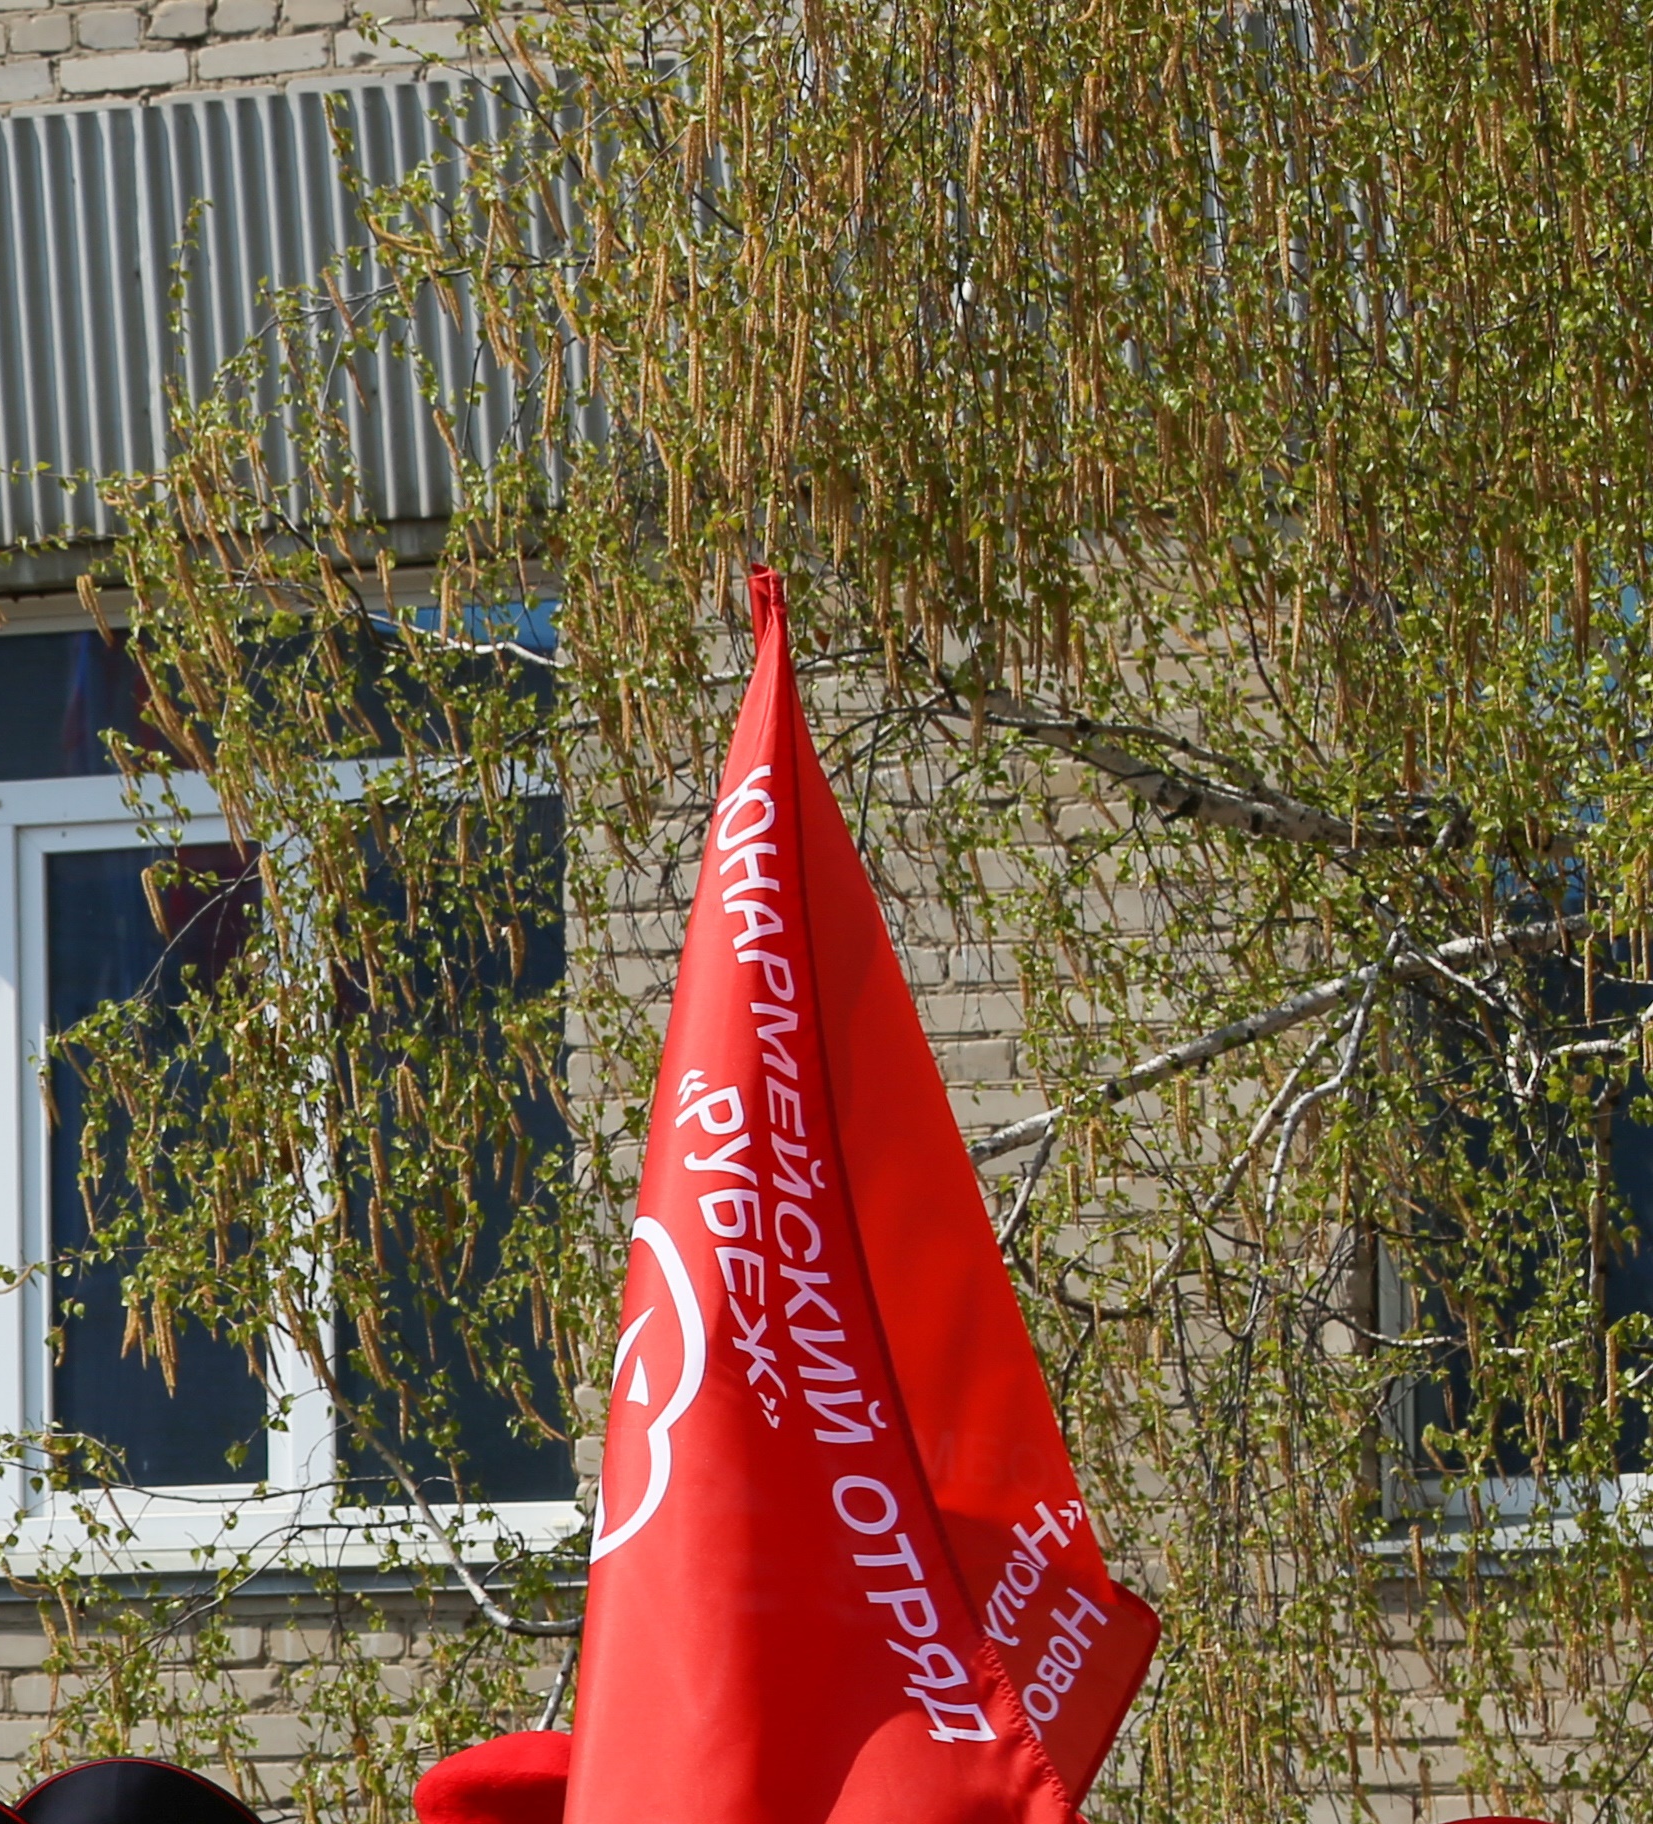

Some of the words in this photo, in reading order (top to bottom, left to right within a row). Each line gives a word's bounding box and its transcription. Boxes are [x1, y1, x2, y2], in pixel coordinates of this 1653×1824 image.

[675, 1069, 787, 1429] «РУБЕЖ»
[716, 764, 887, 1445] ЮНАРМЕЙСКИЙ
[832, 1475, 997, 1743] ОТРЯД
